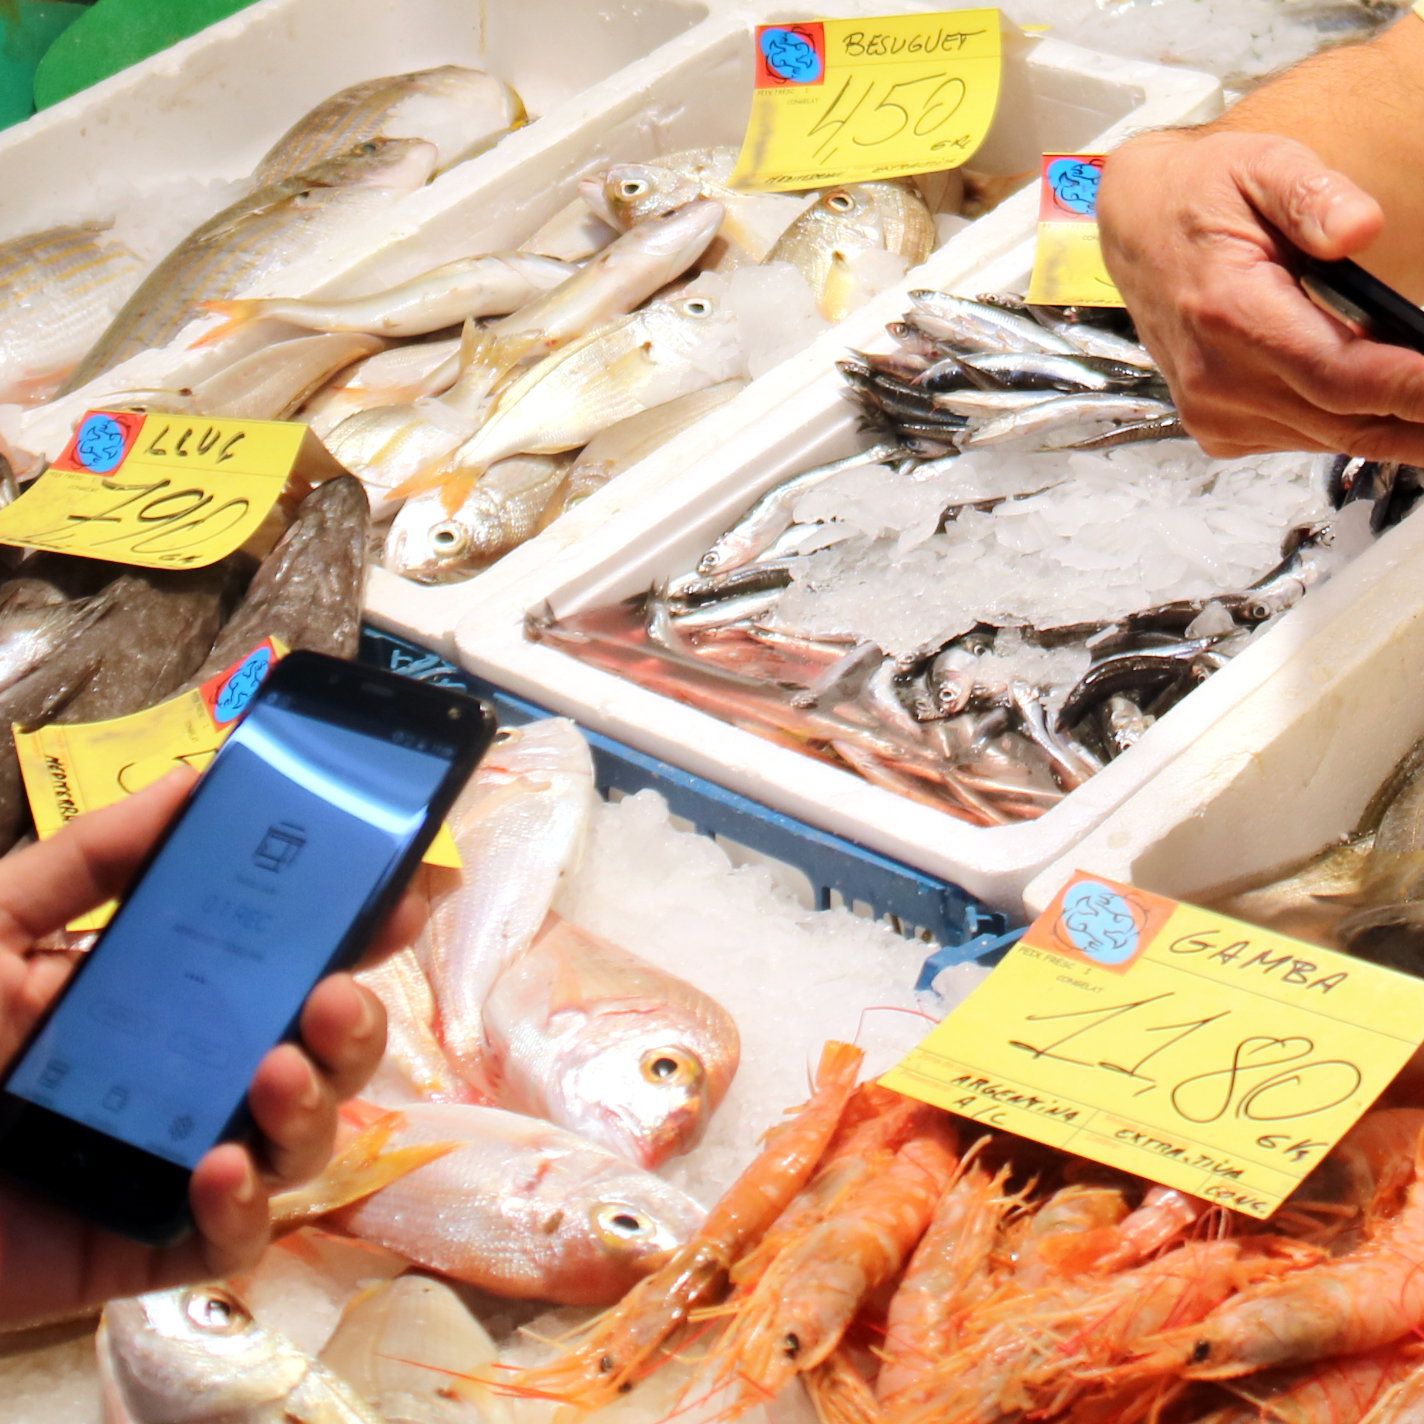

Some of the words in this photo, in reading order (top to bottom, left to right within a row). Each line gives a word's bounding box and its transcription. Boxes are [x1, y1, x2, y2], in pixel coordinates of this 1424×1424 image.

[843, 29, 986, 57] BESUGUET
[1169, 929, 1349, 994] GAMBA
[1008, 991, 1362, 1123] 11,80
